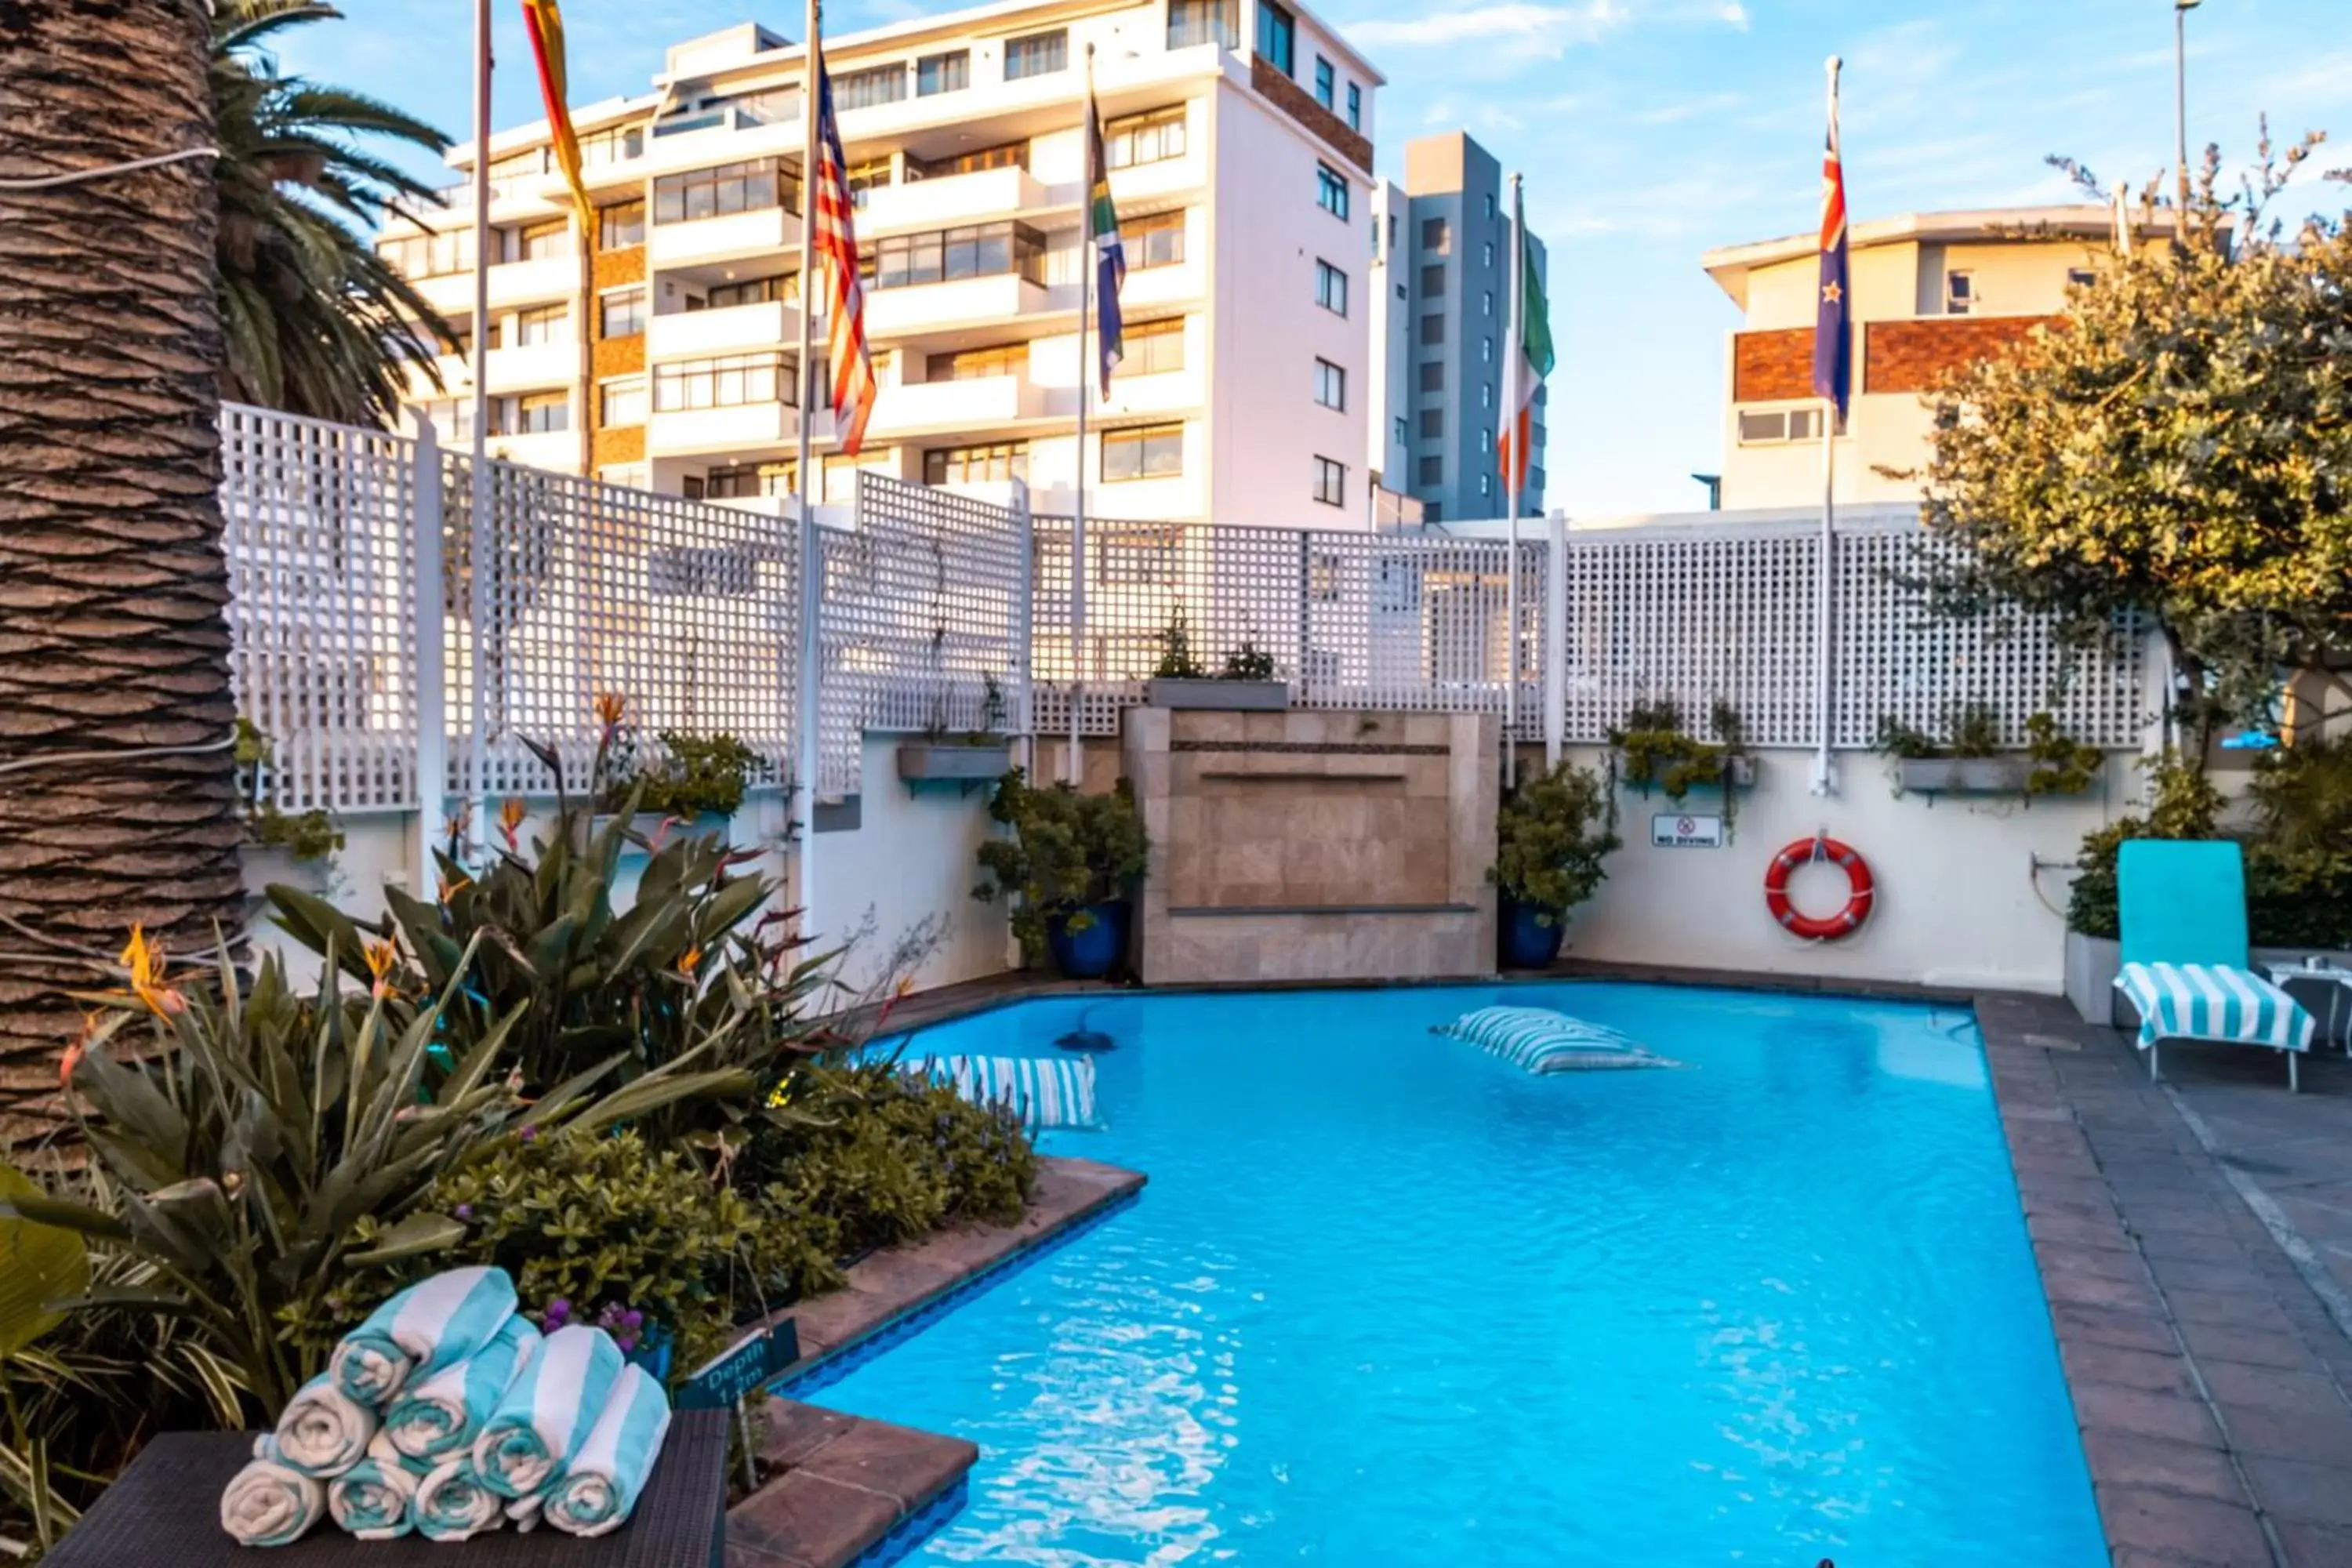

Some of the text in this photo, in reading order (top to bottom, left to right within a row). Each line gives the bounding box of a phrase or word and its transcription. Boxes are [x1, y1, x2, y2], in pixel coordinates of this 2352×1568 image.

[1657, 835, 1715, 845] NO DIVING
[708, 1341, 764, 1391] Depth
